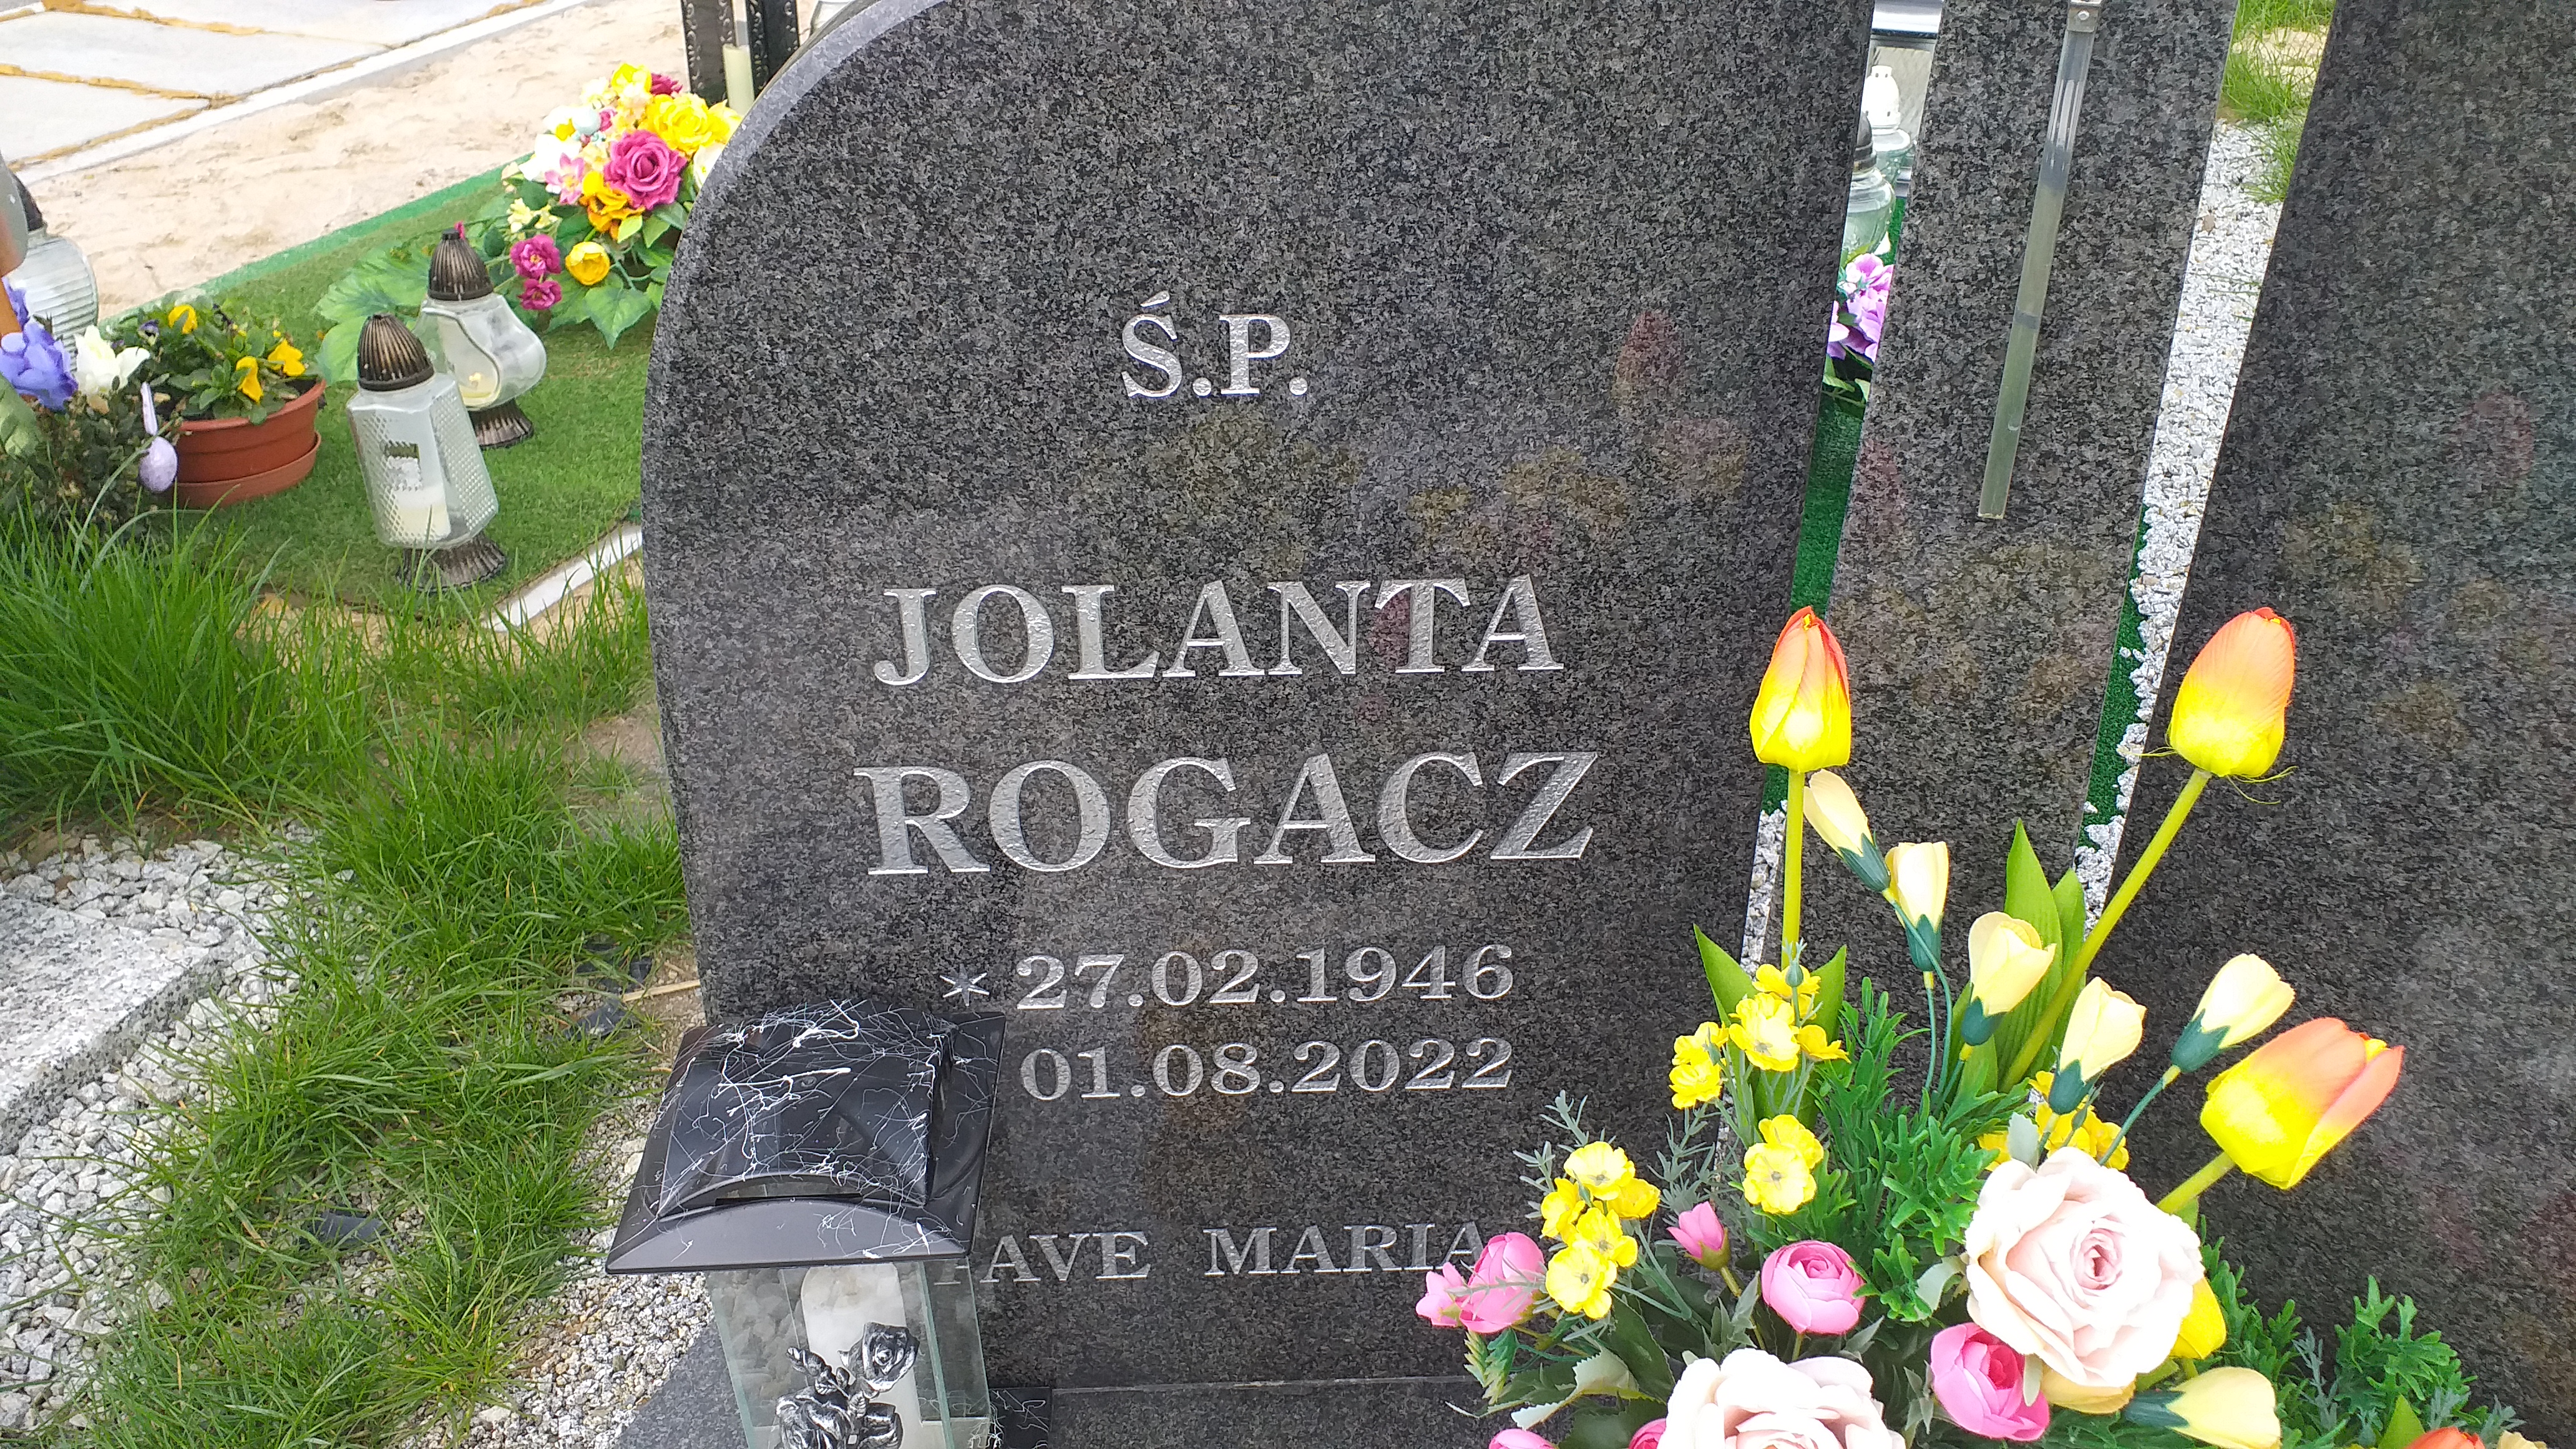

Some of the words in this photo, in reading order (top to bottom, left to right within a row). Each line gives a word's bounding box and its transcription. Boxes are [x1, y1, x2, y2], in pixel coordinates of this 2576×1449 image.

[1121, 290, 1308, 398] Ś.P.
[874, 573, 1564, 686] JOLANTA
[853, 751, 1598, 875] ROGACZ
[1016, 944, 1514, 1010] 27.02.1946
[1020, 1038, 1514, 1101] 01.08.2022
[979, 1231, 1151, 1284] AVE
[1202, 1221, 1485, 1277] MARIA
